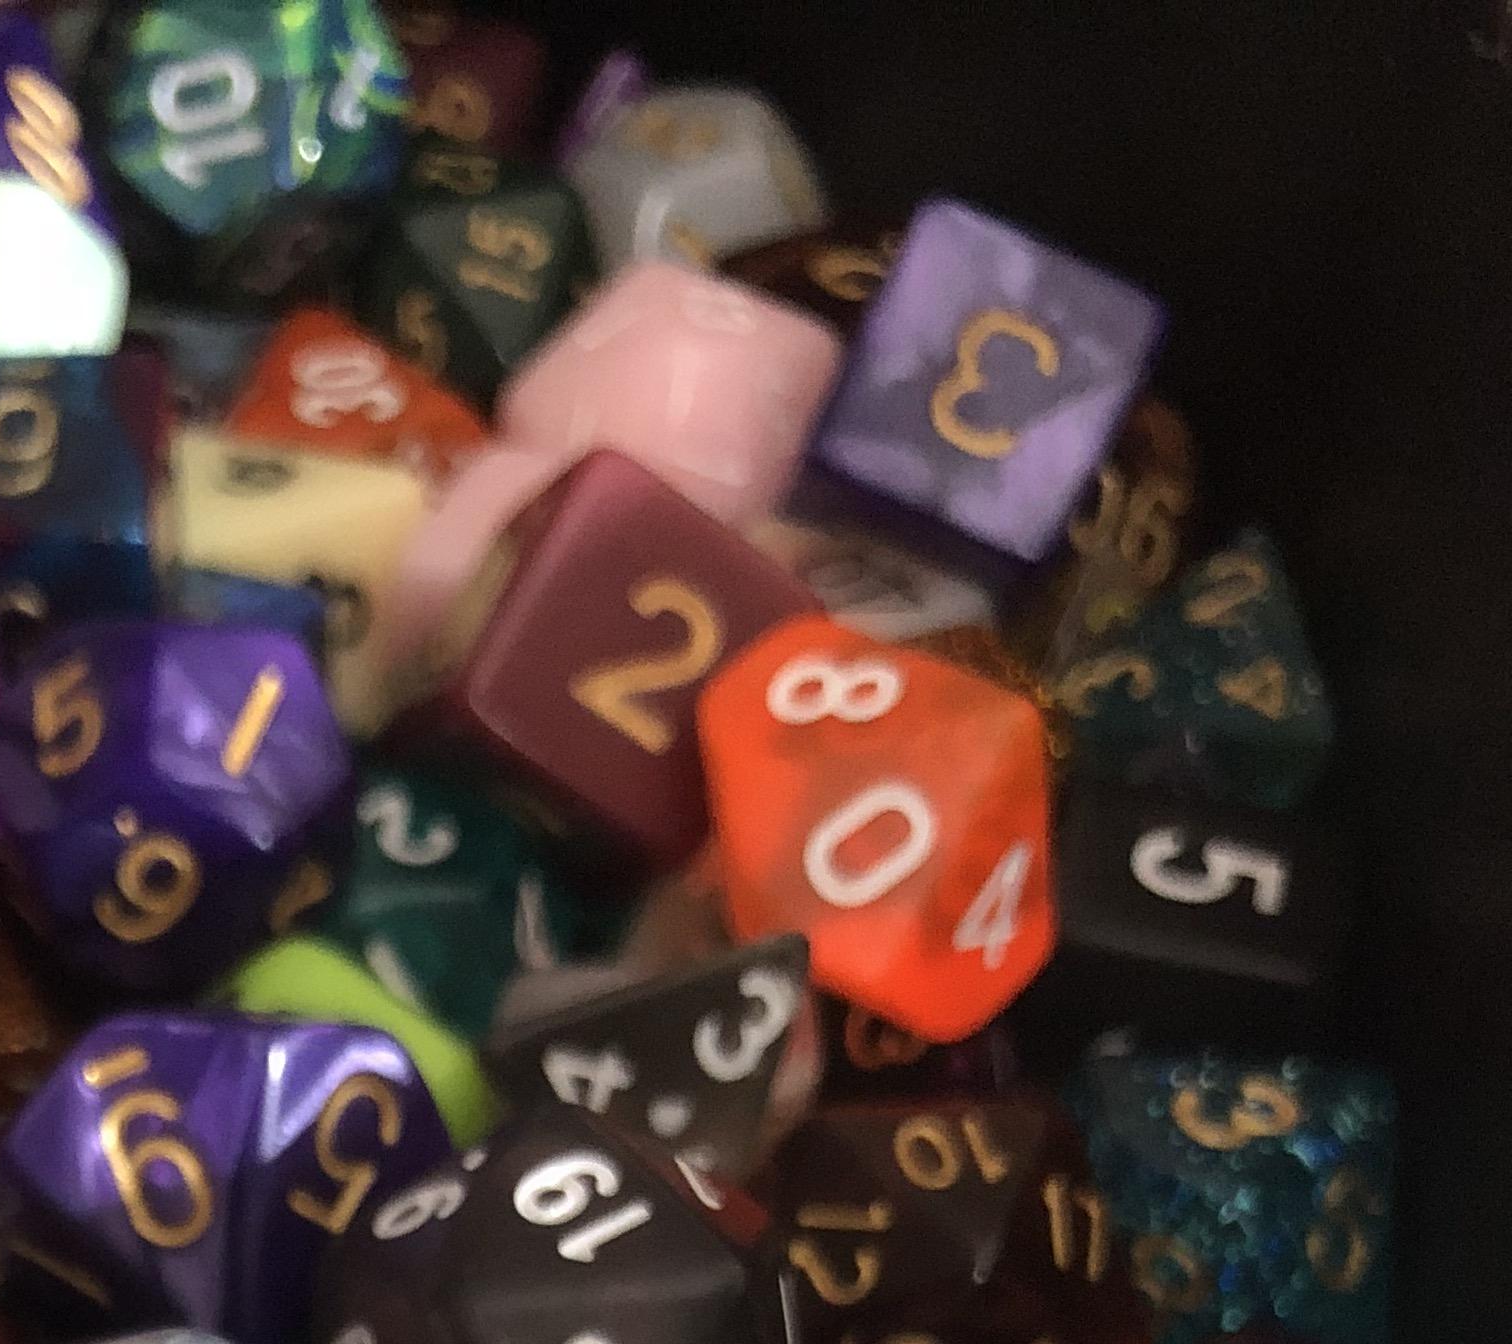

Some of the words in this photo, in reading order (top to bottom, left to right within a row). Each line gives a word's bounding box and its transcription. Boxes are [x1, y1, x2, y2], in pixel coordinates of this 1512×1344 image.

[150, 48, 268, 190] 10
[931, 308, 1060, 460] 3
[33, 658, 105, 778] 5
[568, 578, 723, 757] 2
[766, 658, 906, 725] 8
[803, 782, 938, 908] 0
[953, 840, 1033, 970] 4
[1130, 825, 1286, 915] 5
[543, 1043, 636, 1113] 4
[693, 968, 803, 1083] 3
[290, 1073, 403, 1235] 5
[513, 1150, 653, 1262] 19
[893, 1115, 1010, 1190] 10
